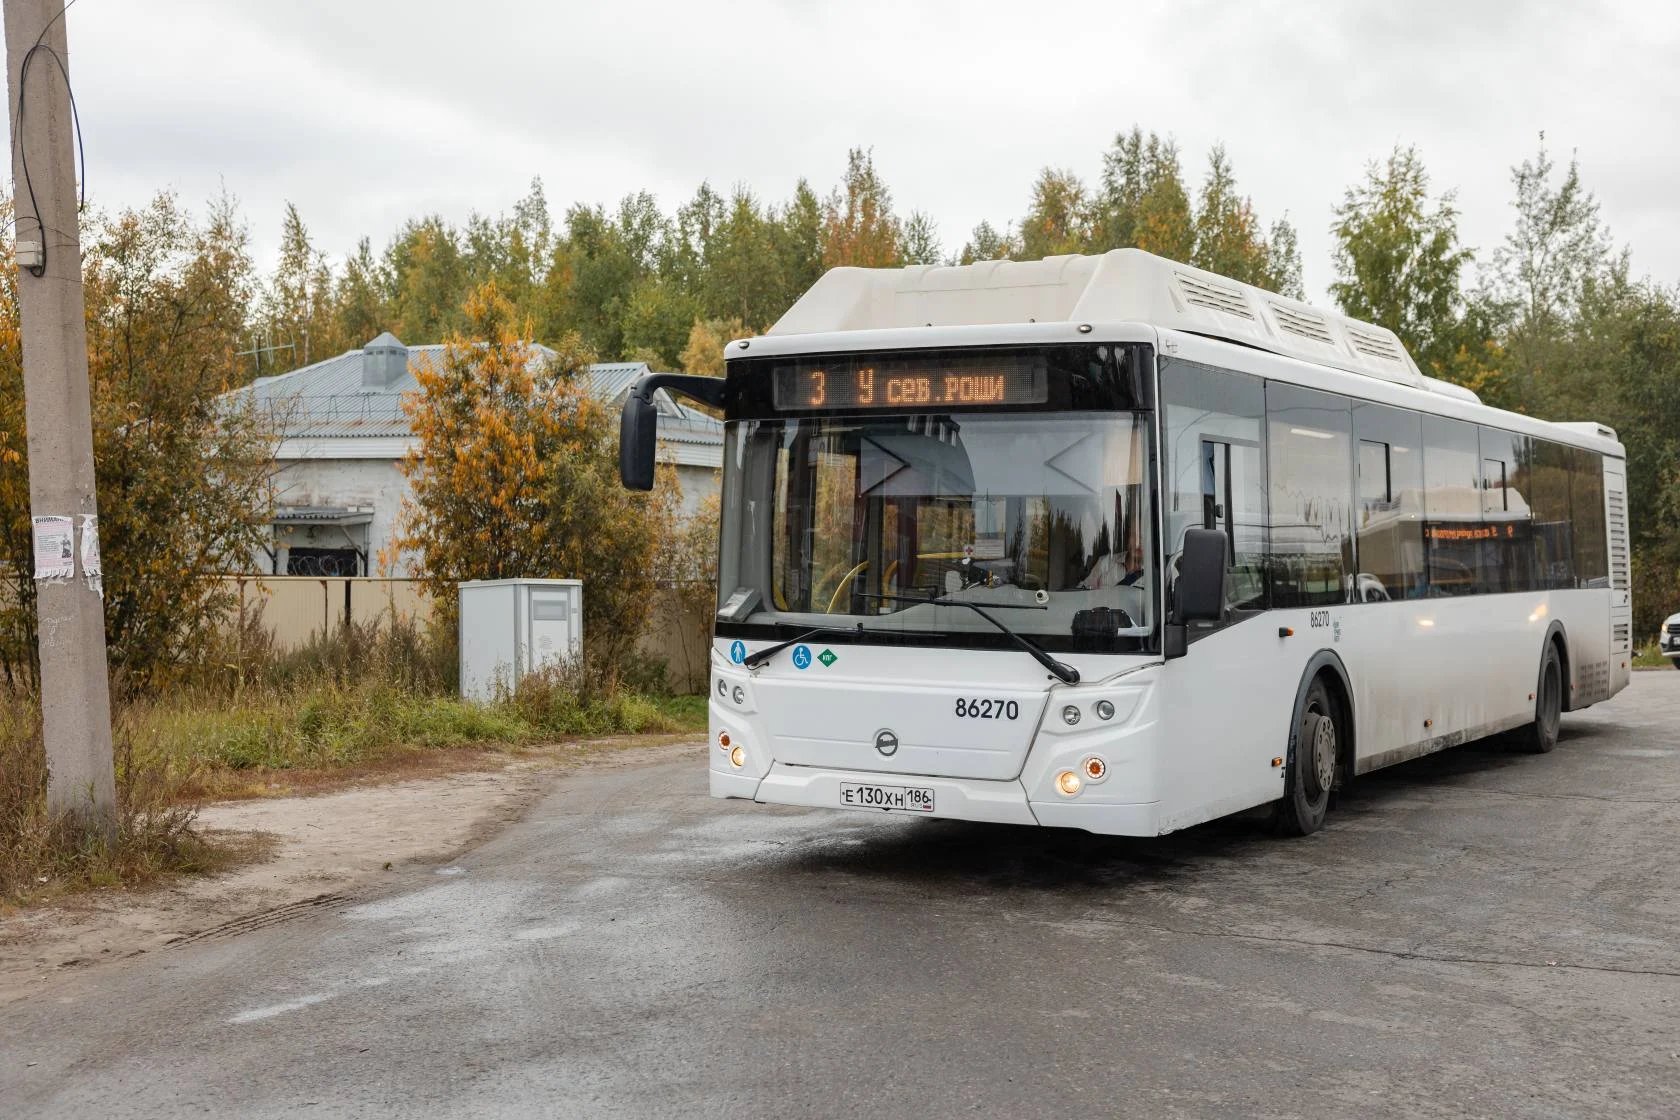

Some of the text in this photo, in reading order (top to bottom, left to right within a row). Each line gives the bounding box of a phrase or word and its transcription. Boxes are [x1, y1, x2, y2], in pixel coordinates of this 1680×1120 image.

[811, 371, 825, 404] 3
[858, 368, 873, 403] У
[1311, 611, 1329, 628] 86270
[955, 698, 1019, 720] 86270
[907, 789, 930, 803] 186
